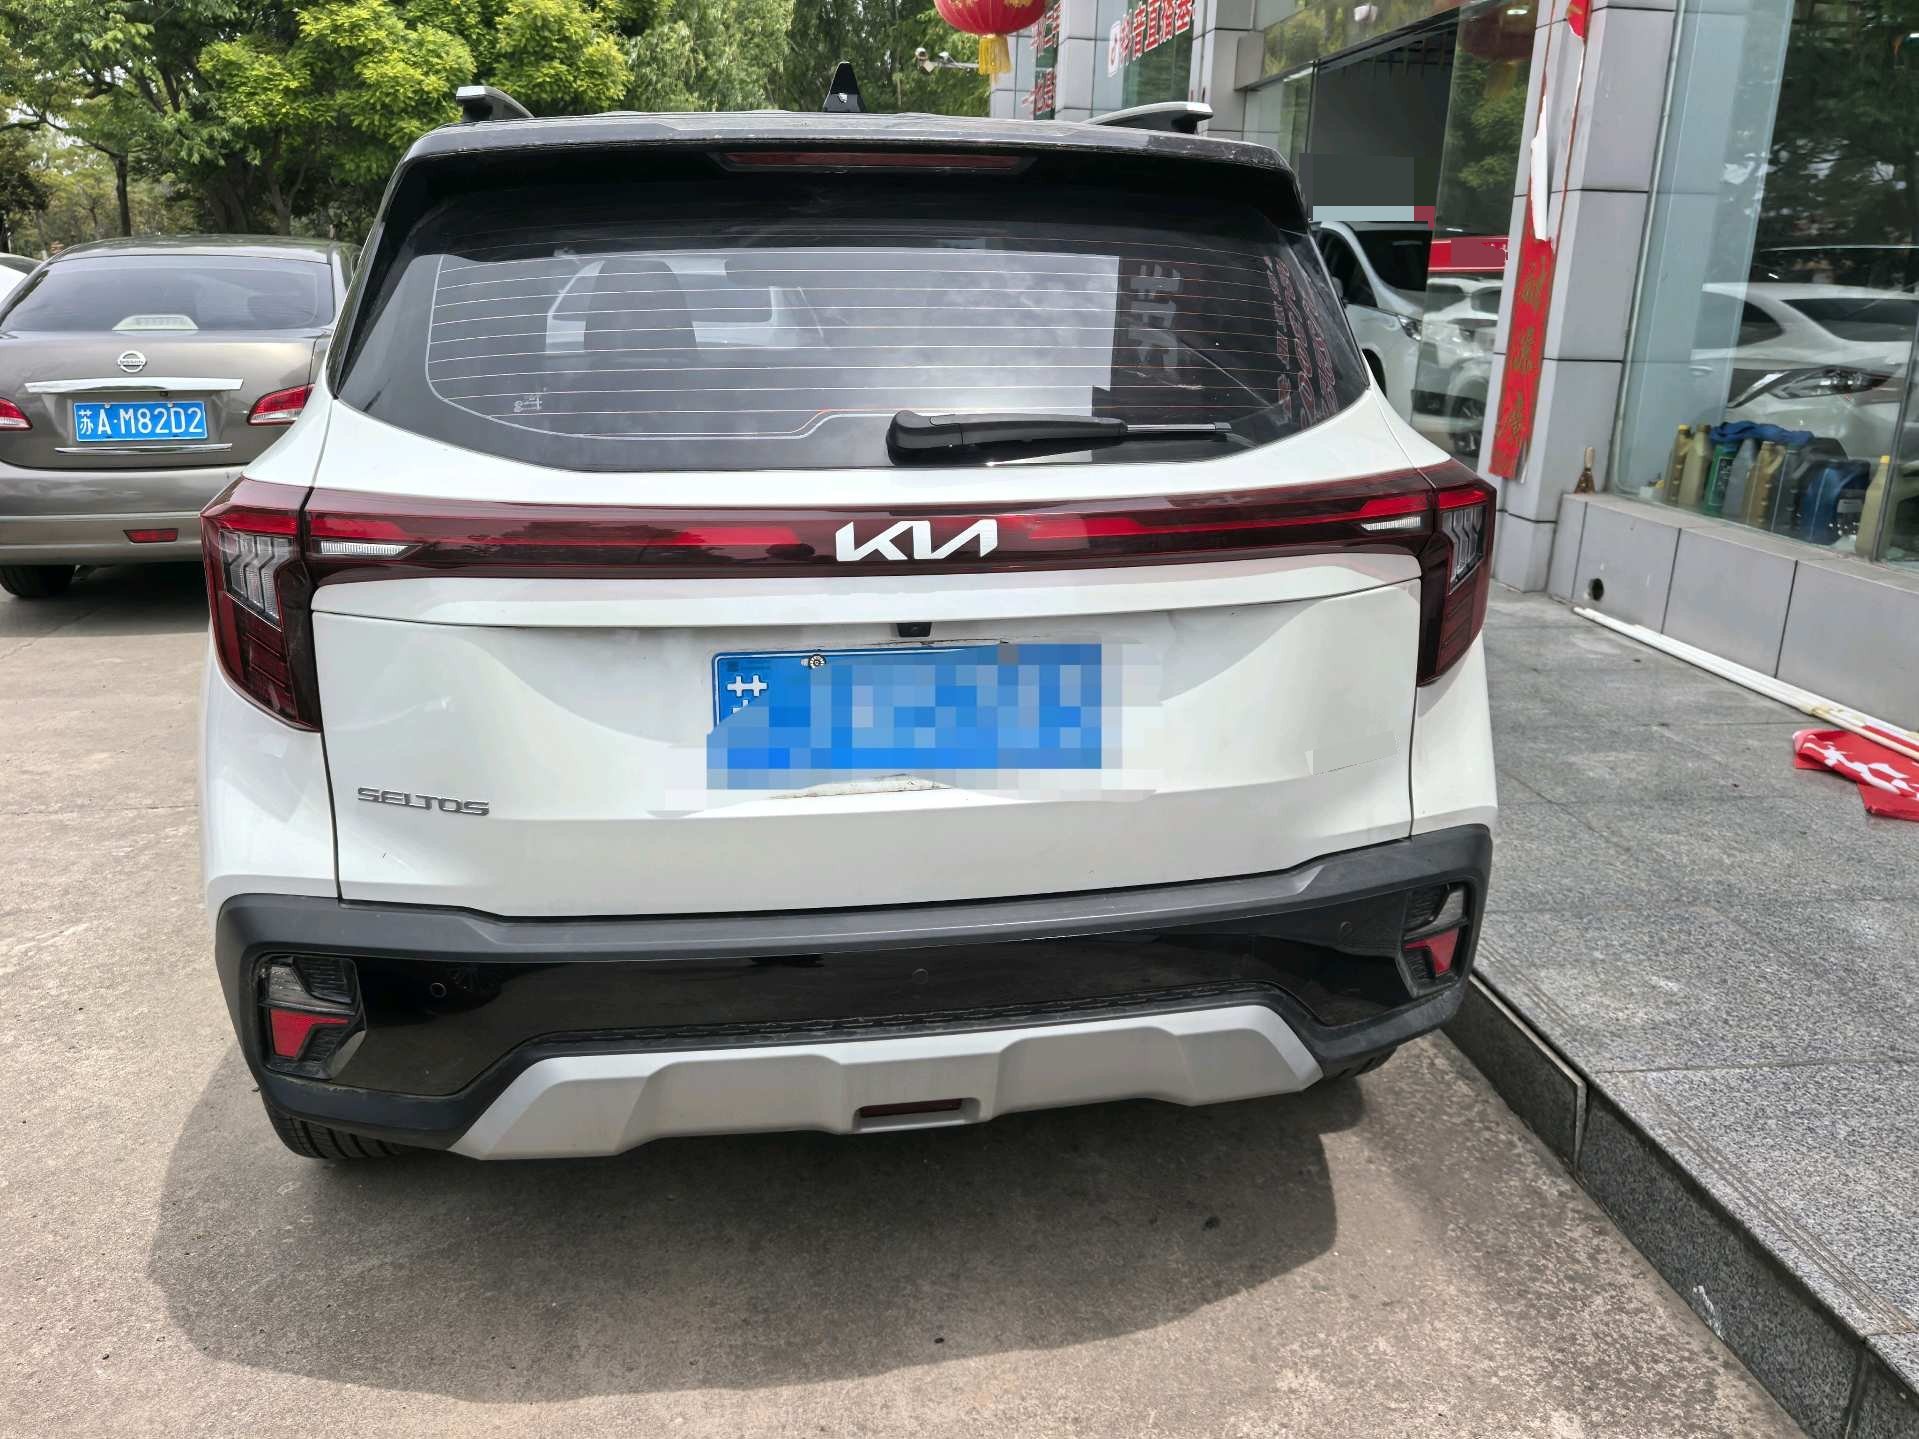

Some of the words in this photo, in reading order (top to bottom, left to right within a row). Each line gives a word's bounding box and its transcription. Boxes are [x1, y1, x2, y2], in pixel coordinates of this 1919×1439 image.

[78, 407, 204, 435] 苏A·M82D2
[835, 519, 998, 562] KIA
[358, 787, 490, 816] SELTOS
